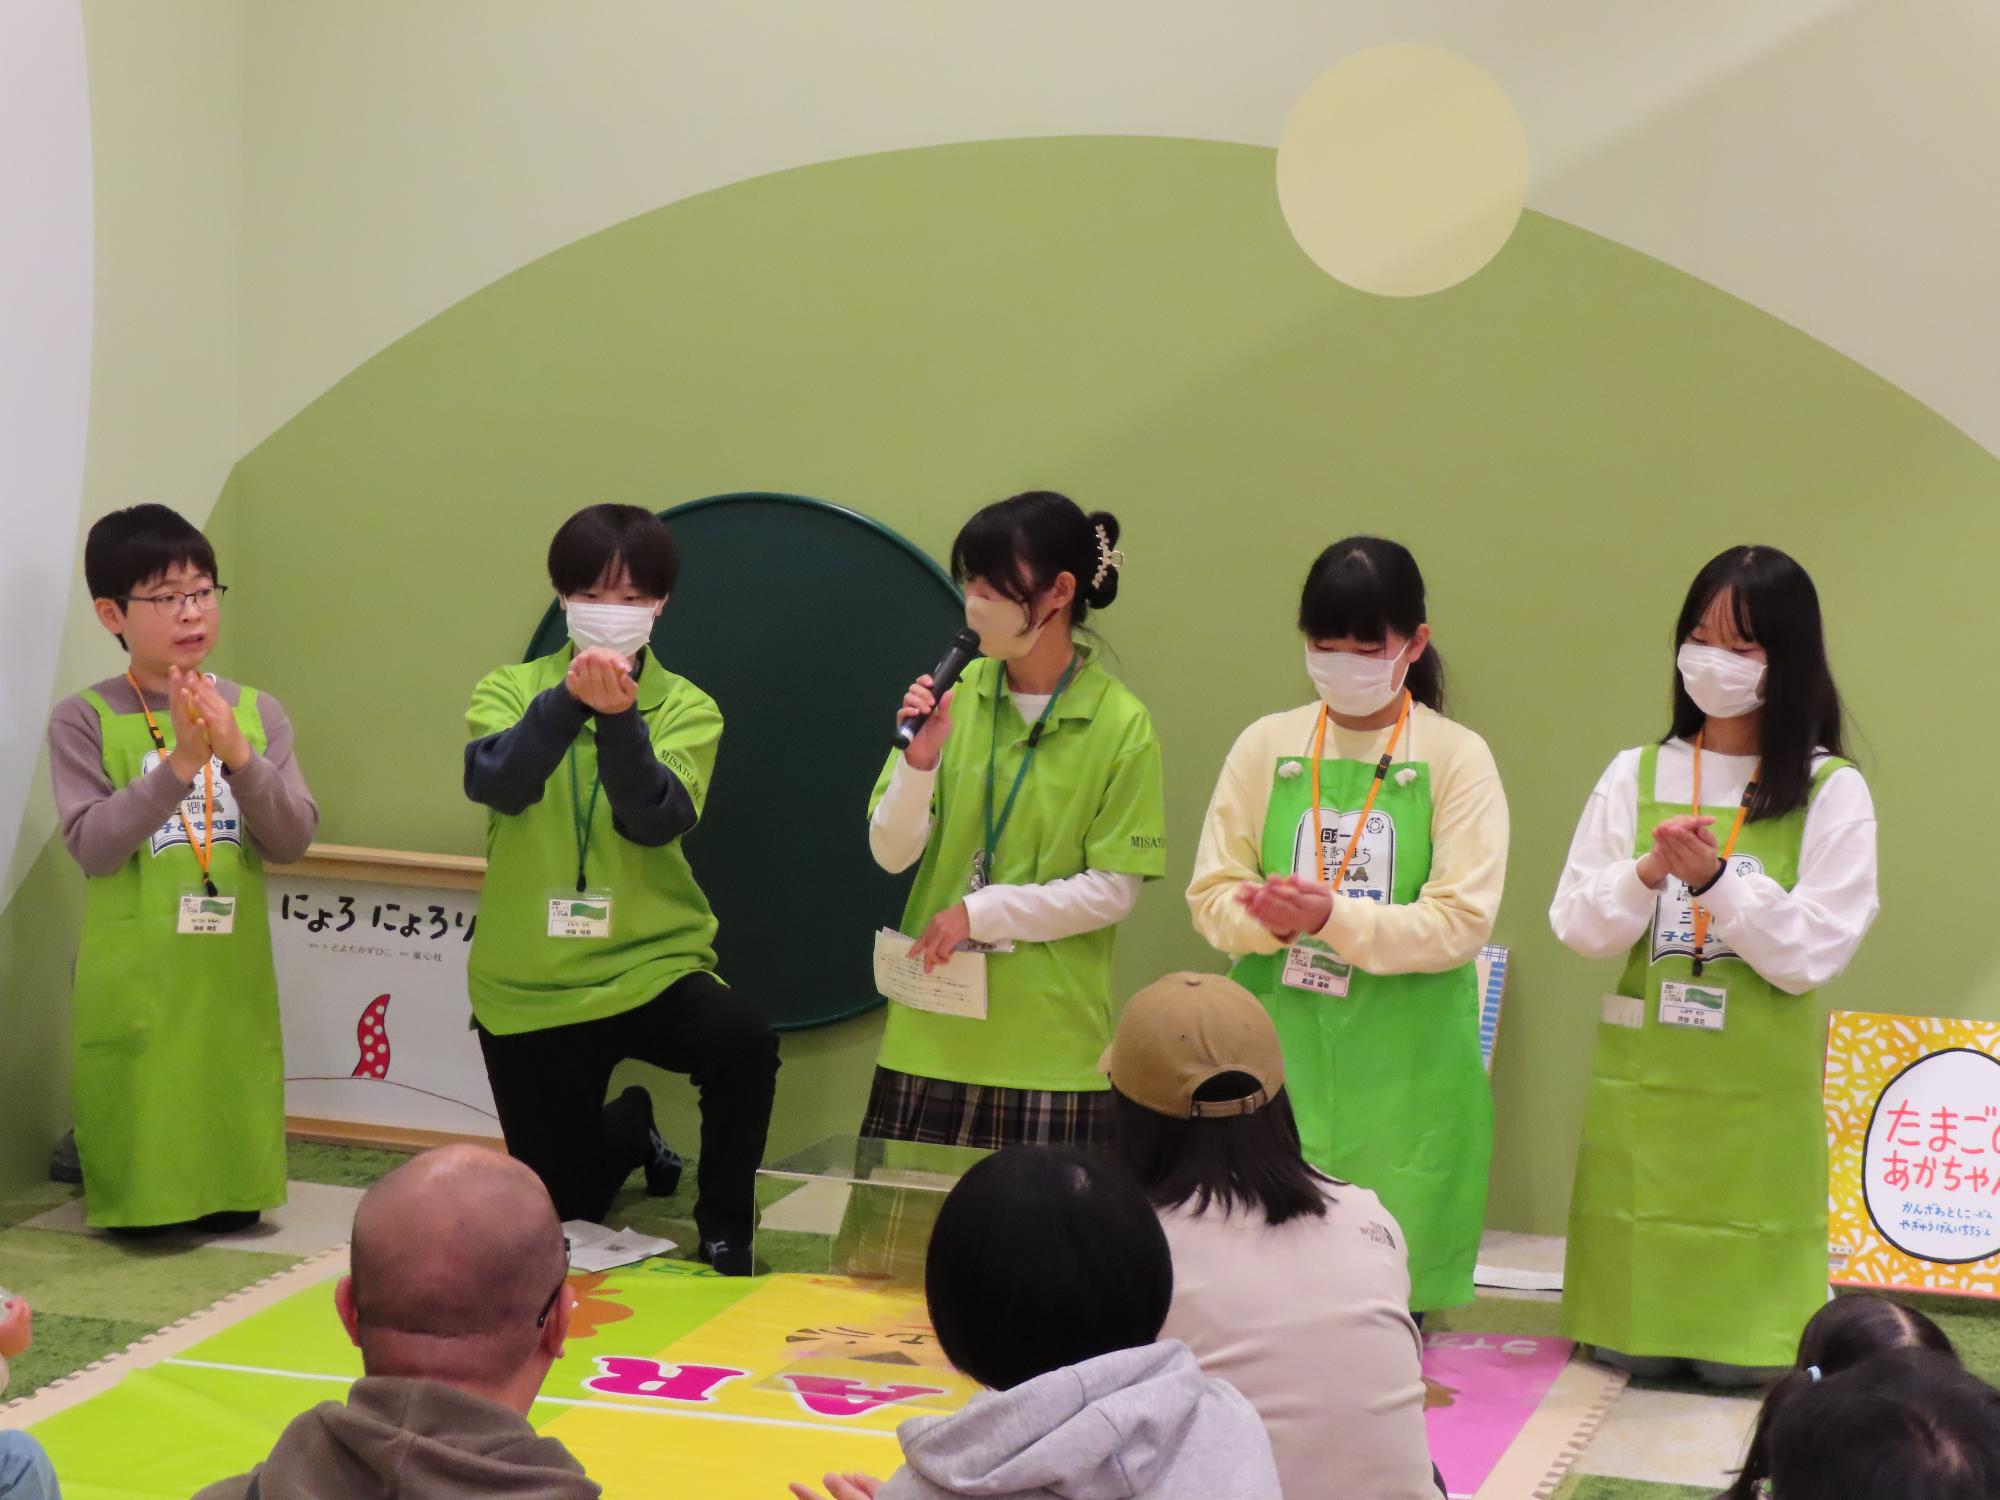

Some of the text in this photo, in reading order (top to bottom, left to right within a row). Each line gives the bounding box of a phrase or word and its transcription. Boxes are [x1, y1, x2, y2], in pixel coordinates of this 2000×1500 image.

[282, 893, 476, 942] にょろ にょろり
